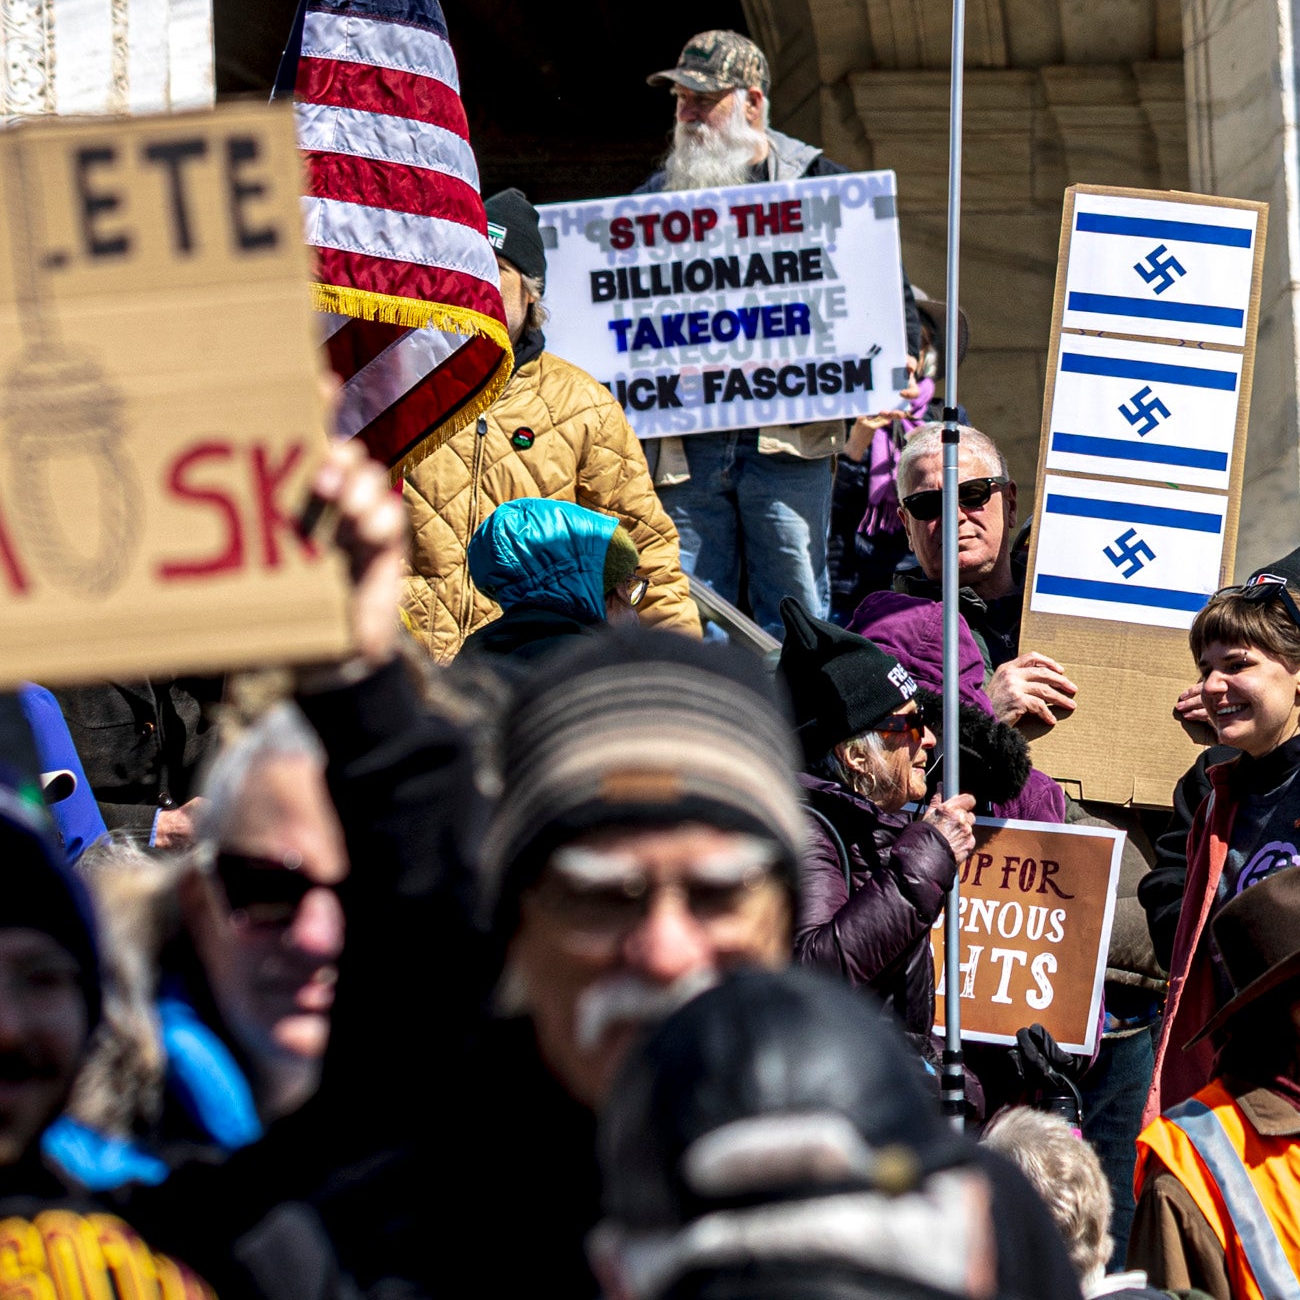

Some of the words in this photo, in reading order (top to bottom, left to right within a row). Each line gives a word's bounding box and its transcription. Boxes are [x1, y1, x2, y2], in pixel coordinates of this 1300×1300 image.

[609, 207, 718, 250] STOP
[730, 200, 804, 238] THE
[590, 247, 823, 303] BILLIONARE
[608, 302, 811, 353] TAKEOVER
[601, 373, 683, 411] UCK
[999, 856, 1075, 900] FOR
[936, 943, 1058, 1011] HTS
